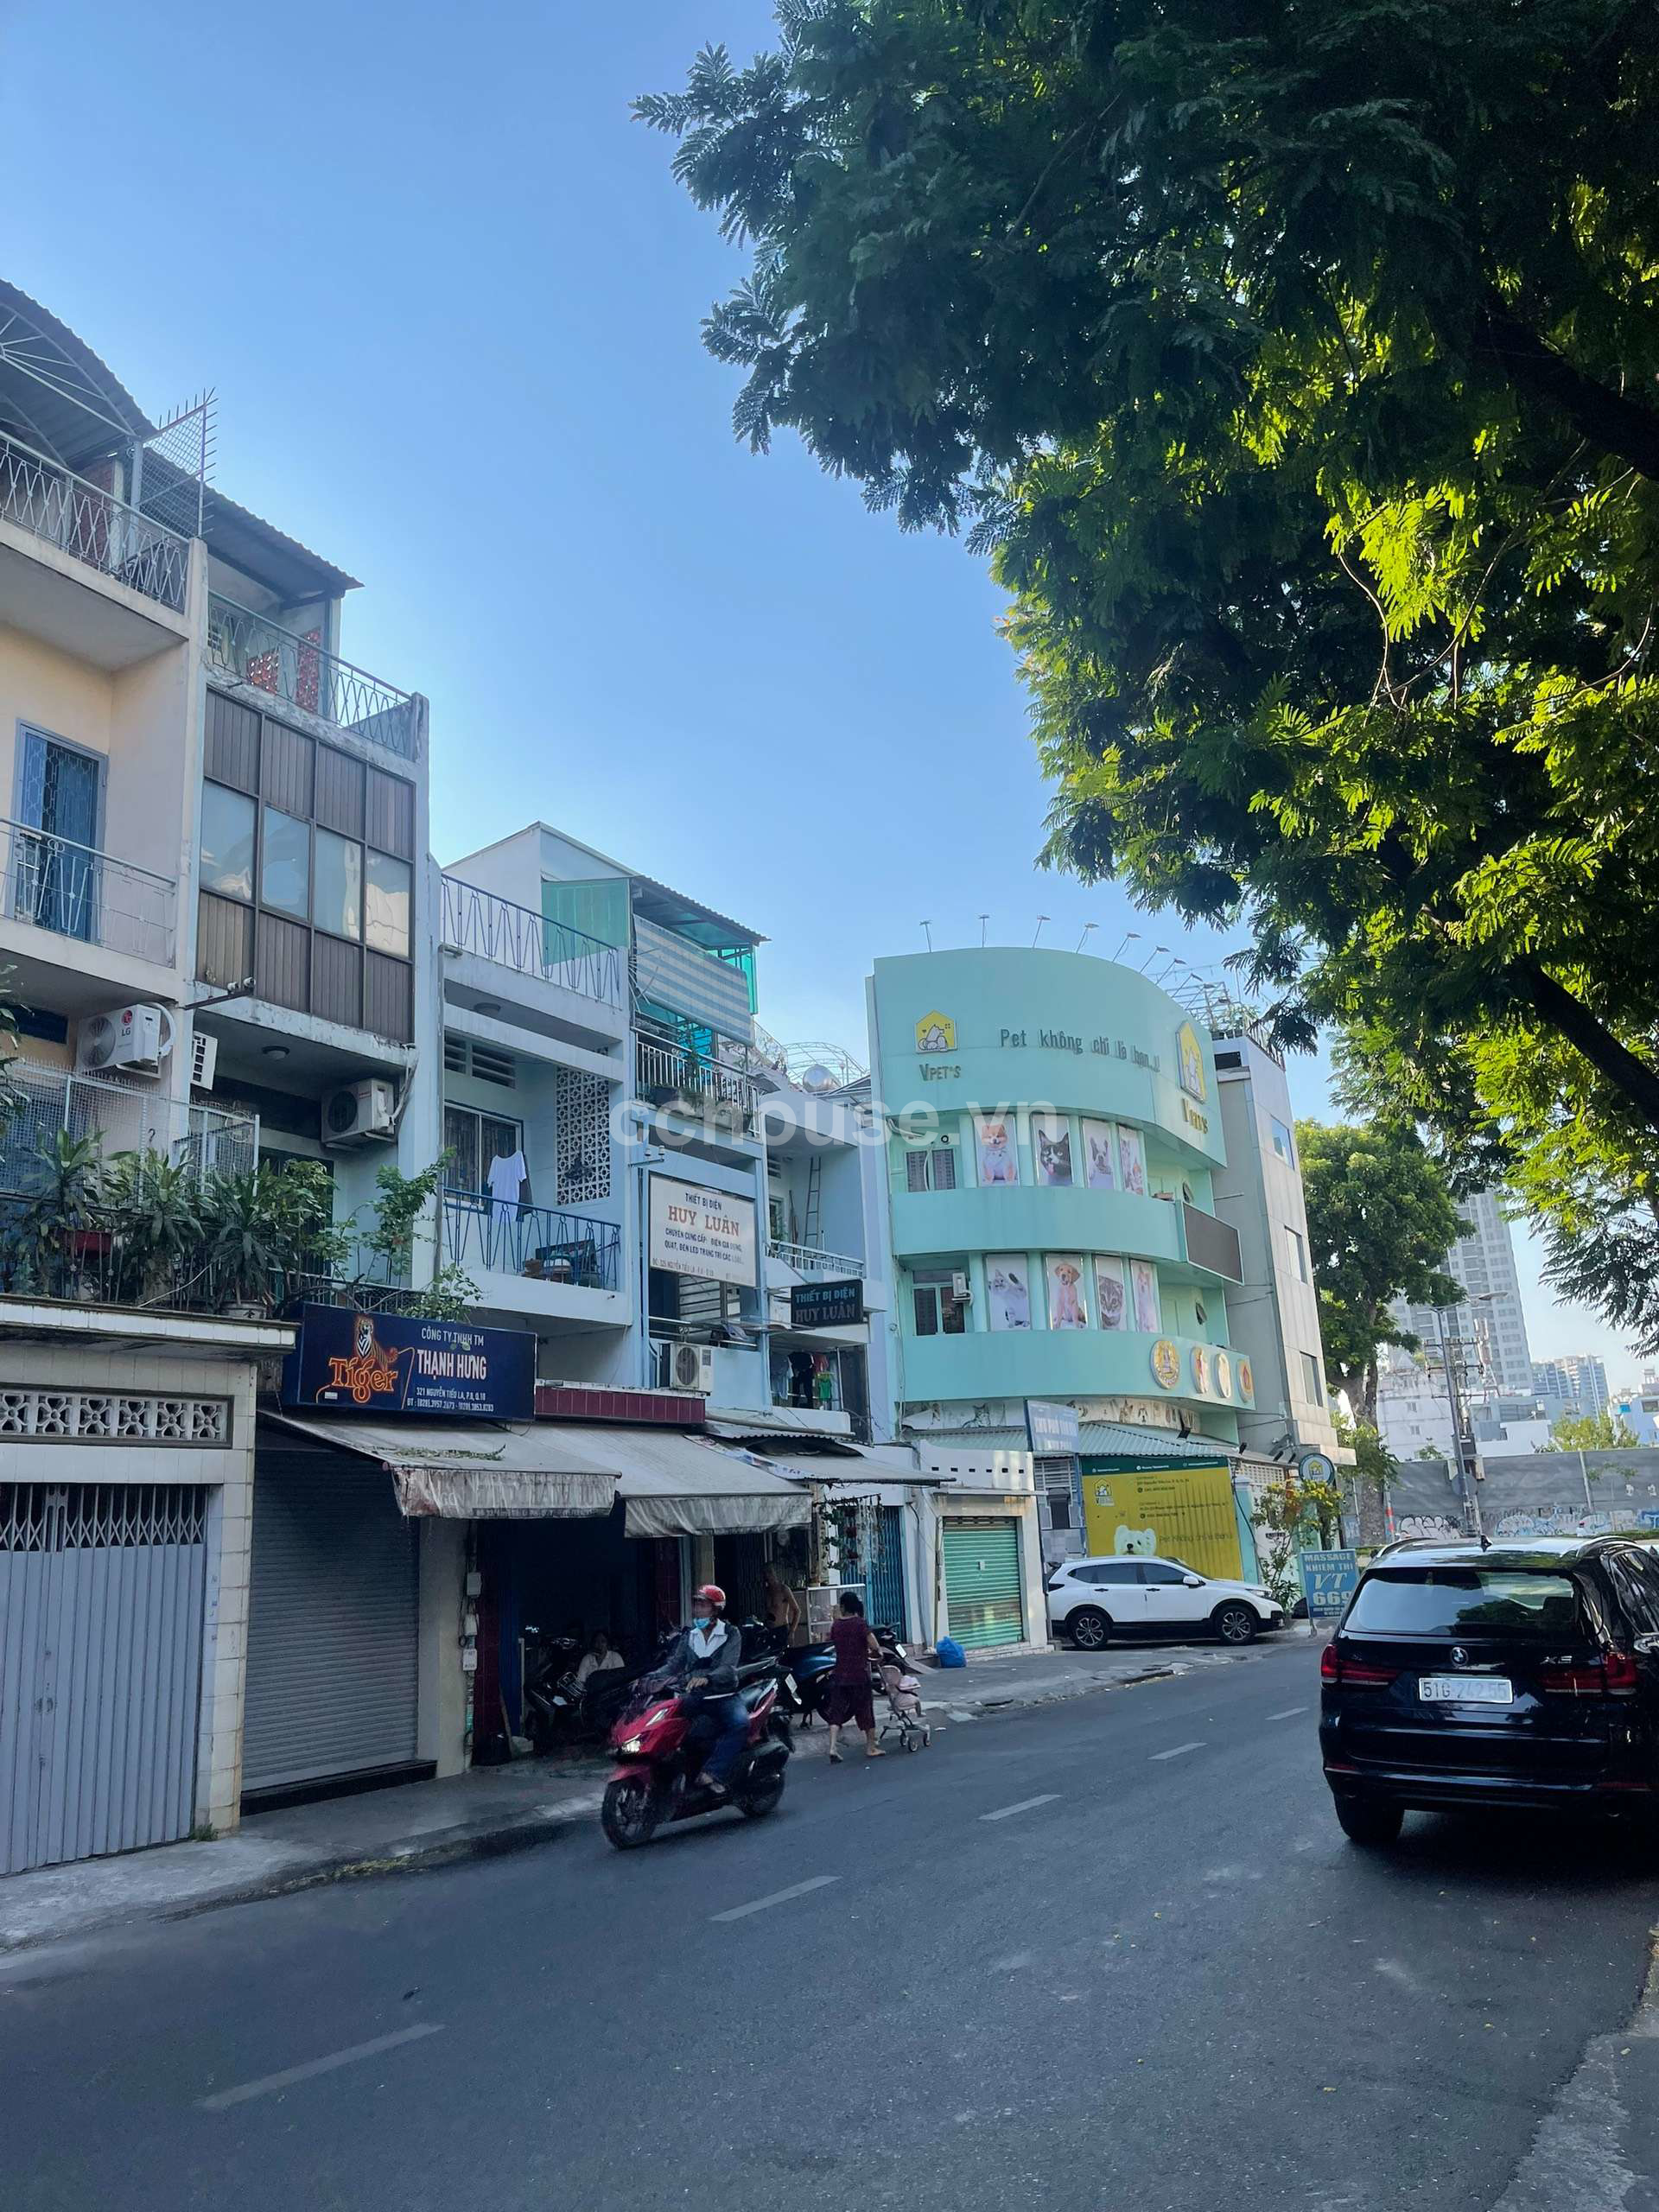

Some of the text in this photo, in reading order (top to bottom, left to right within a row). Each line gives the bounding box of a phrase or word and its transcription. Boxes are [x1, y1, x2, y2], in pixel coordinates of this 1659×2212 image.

[121, 1027, 131, 1037] LG
[1000, 1028, 1027, 1048] Pet
[1039, 1029, 1084, 1055] không
[685, 1192, 701, 1205] THIẾT
[668, 1205, 740, 1236] HUY LUÂN
[795, 1287, 855, 1304] THIẾT BỊ ĐIỆN
[795, 1301, 855, 1323] HUY LUÂN
[421, 1325, 442, 1341] CÔNG
[443, 1331, 453, 1343] TY
[474, 1334, 484, 1346] TM
[416, 1349, 486, 1380] THẠNH HƯNG
[328, 1357, 398, 1403] Tiger
[1304, 1553, 1352, 1562] MASSAGE
[1314, 1573, 1348, 1590] VT
[1423, 1681, 1451, 1698] 51G
